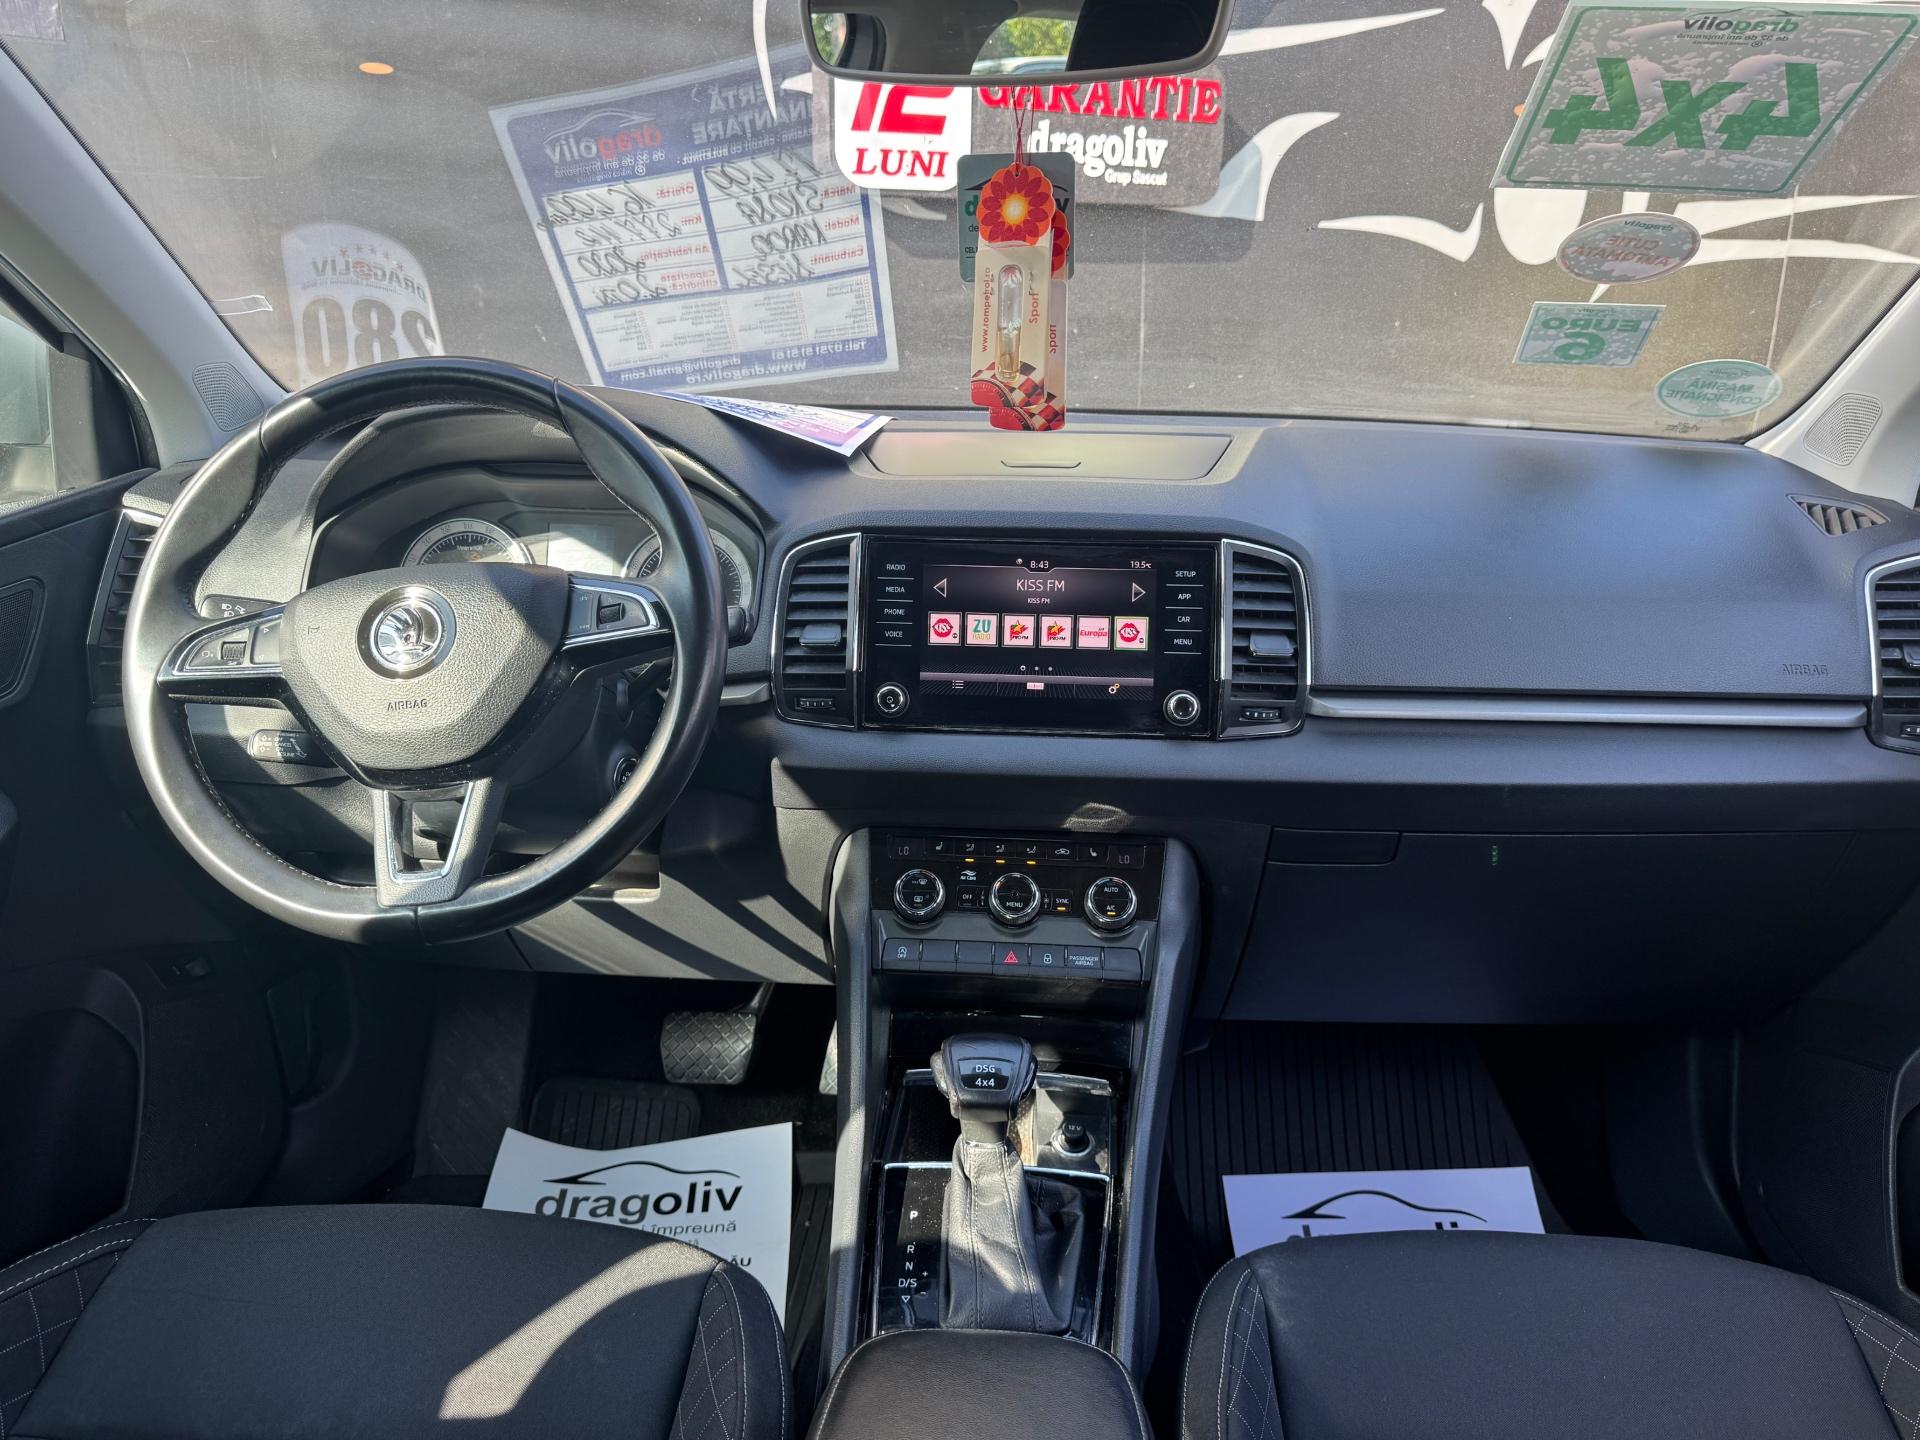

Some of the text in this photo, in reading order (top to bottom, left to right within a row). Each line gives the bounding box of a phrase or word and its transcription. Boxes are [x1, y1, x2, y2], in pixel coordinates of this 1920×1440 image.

[976, 76, 1223, 125] GARANTIE
[1026, 118, 1169, 178] dragoliv
[851, 147, 950, 179] LUNI
[1028, 292, 1040, 324] Sport
[886, 563, 906, 571] RADIO
[1029, 560, 1049, 570] 8:43
[1175, 570, 1196, 578] SETUP
[885, 585, 905, 594] MEDIA
[1016, 579, 1066, 592] KISS FM
[1178, 592, 1192, 600] APP
[884, 608, 905, 616] PHONE
[1177, 615, 1190, 623] CAR
[973, 619, 992, 634] ZU
[884, 630, 903, 639] VOICE
[1080, 629, 1108, 638] Europa
[1173, 638, 1193, 646] MENU
[1782, 662, 1829, 676] AIRBAG
[387, 698, 428, 711] AIRBAG
[898, 845, 910, 856] LO
[1118, 854, 1130, 865] LO
[975, 1064, 996, 1073] DSG
[975, 1078, 995, 1087] 4x4
[534, 1180, 743, 1226] dragoliv
[909, 1210, 919, 1221] P
[651, 1219, 737, 1237] împreună
[906, 1244, 915, 1254] R
[905, 1261, 913, 1271] N
[898, 1278, 918, 1289] D/S
